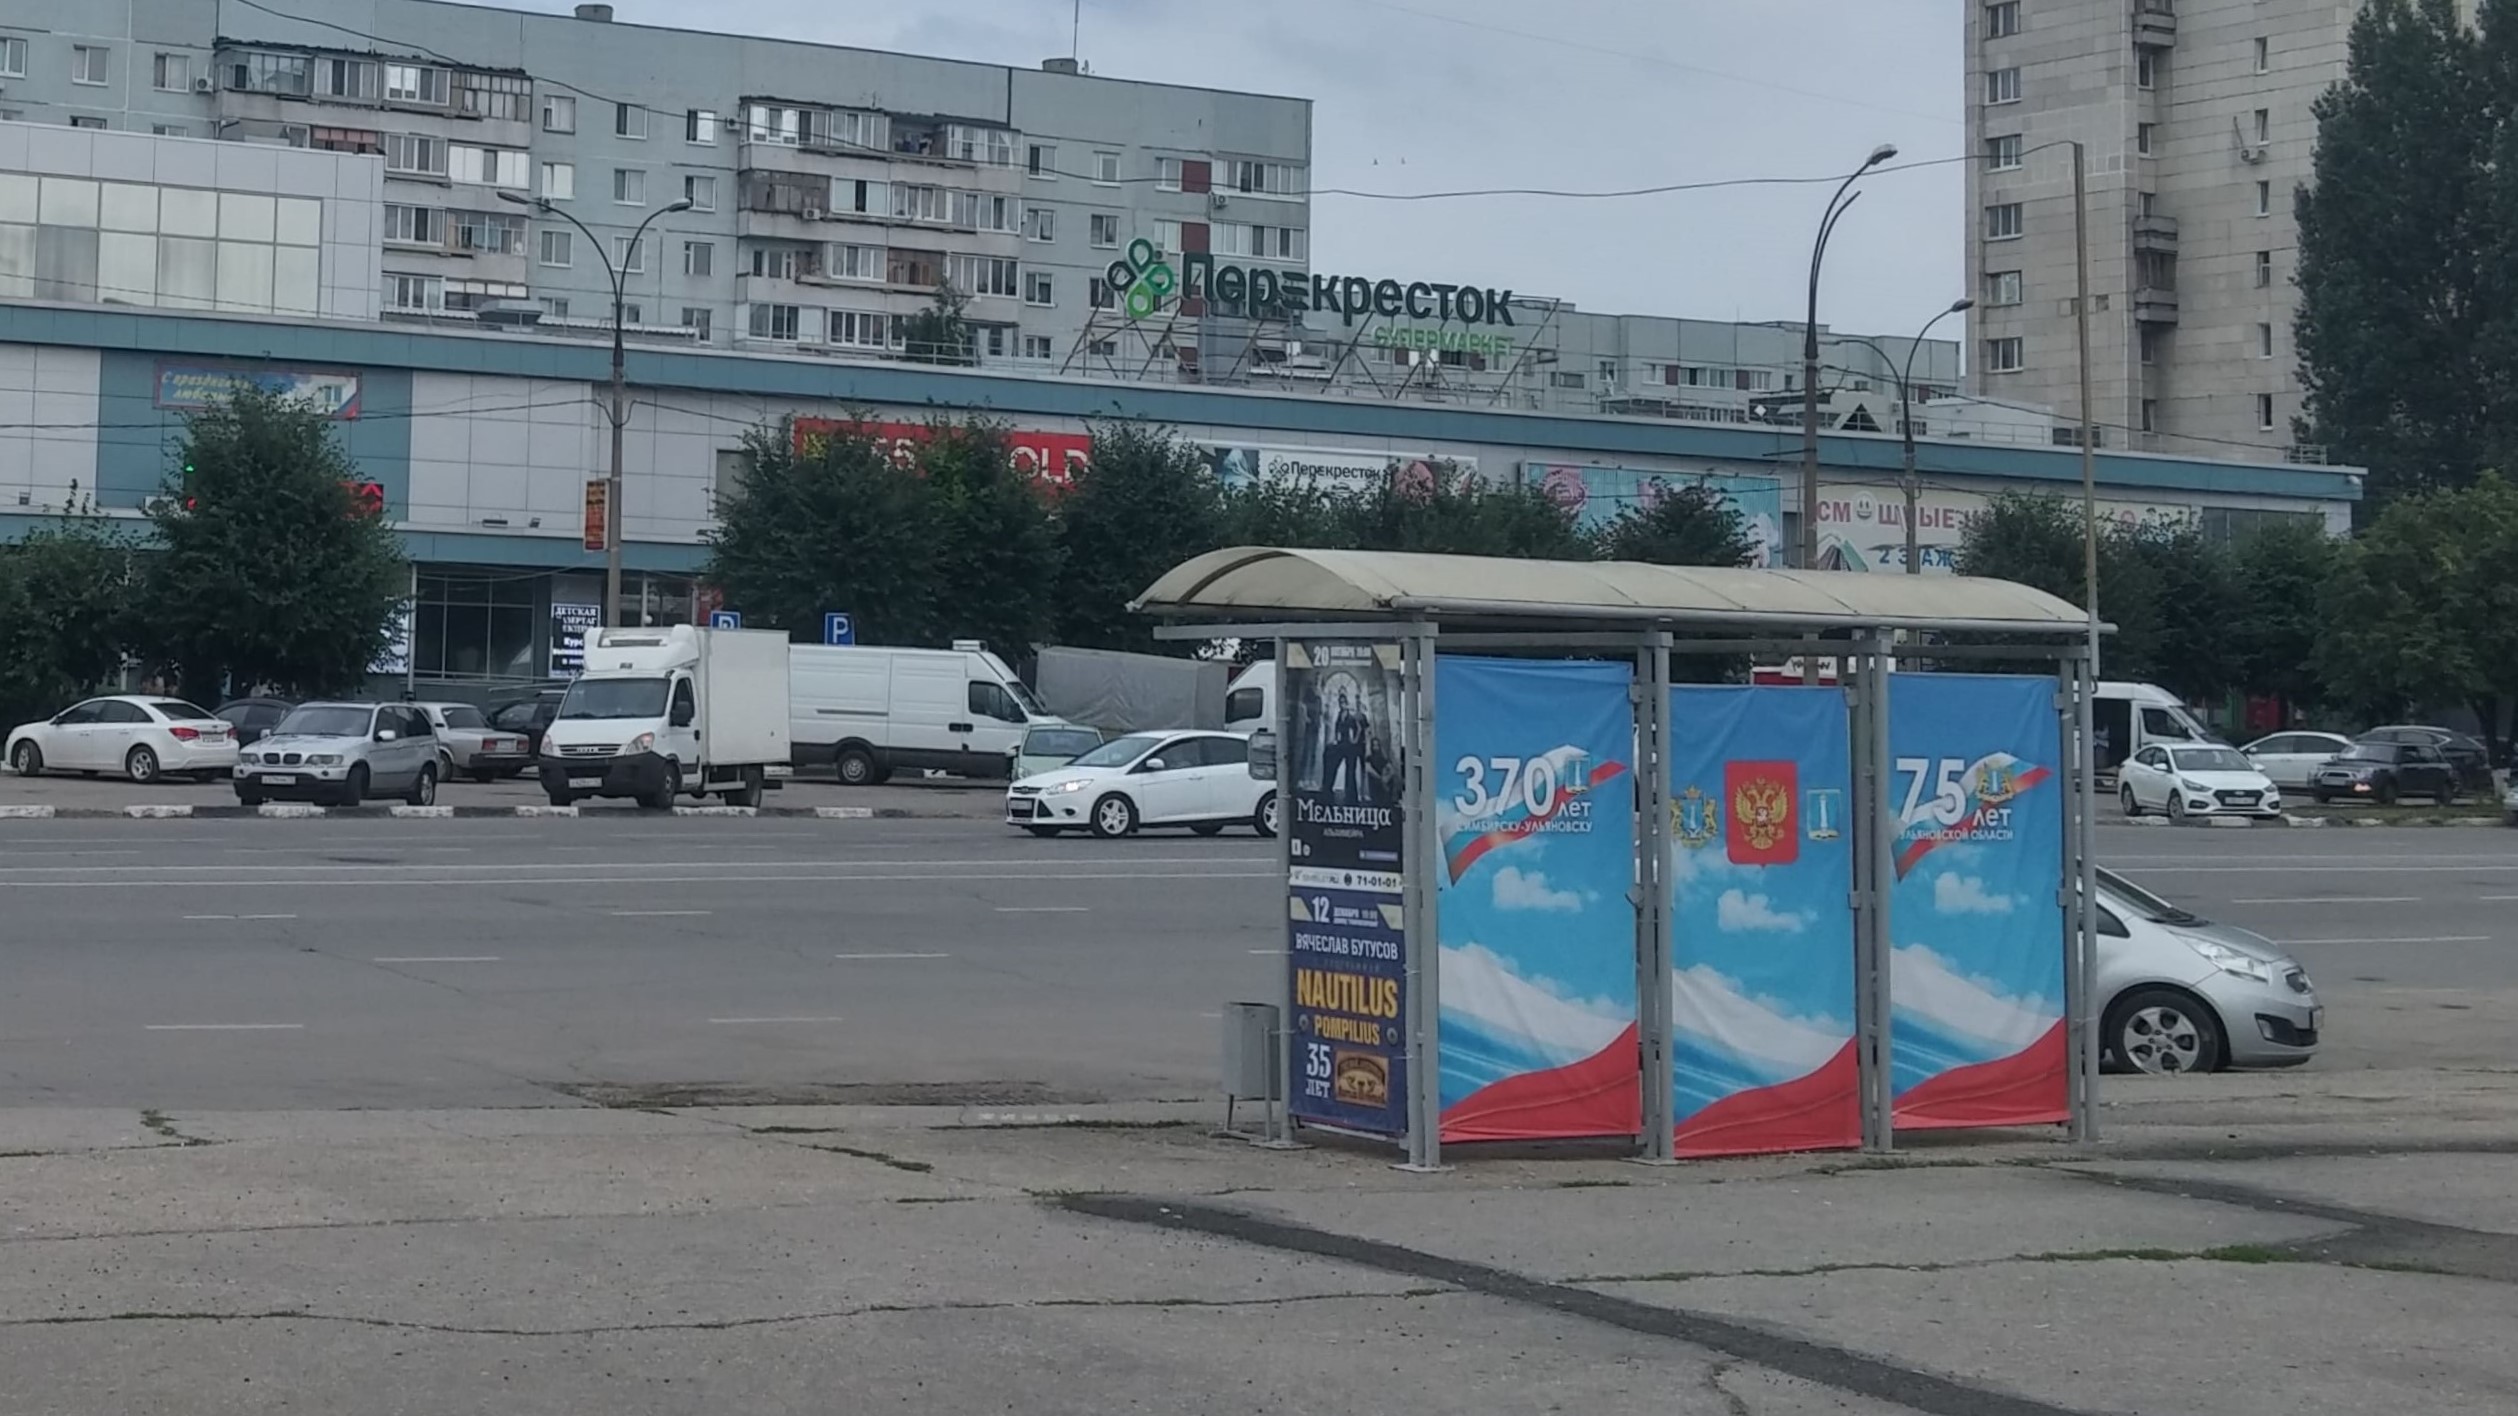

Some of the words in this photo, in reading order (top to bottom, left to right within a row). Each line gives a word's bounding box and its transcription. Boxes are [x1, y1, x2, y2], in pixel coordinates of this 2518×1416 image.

[1373, 325, 1515, 356] СУПЕРМАРКЕТ
[1290, 461, 1382, 481] Перекресток
[1878, 549, 1890, 564] 2
[832, 617, 849, 643] P
[1313, 645, 1329, 667] 20
[1454, 756, 1555, 817] 370
[1557, 801, 1592, 817] лет
[1896, 758, 1967, 826] 75
[1972, 808, 2012, 827] лет
[1296, 798, 1392, 831] Мельница
[1900, 827, 1969, 840] УЛЬЯНОВСКОЙ
[1970, 829, 2014, 841] ОБЛАСТИ
[1357, 874, 1397, 888] 71-01-01
[1312, 896, 1331, 923] 12
[1295, 932, 1350, 955] ВЯЧЕСЛАВ
[1351, 938, 1399, 960] БУТУСОВ
[1297, 967, 1398, 1018] NAUTILUS
[1313, 1014, 1381, 1045] POMPILIUS
[1306, 1042, 1332, 1078] 35
[1305, 1078, 1331, 1098] ЛЕТ
